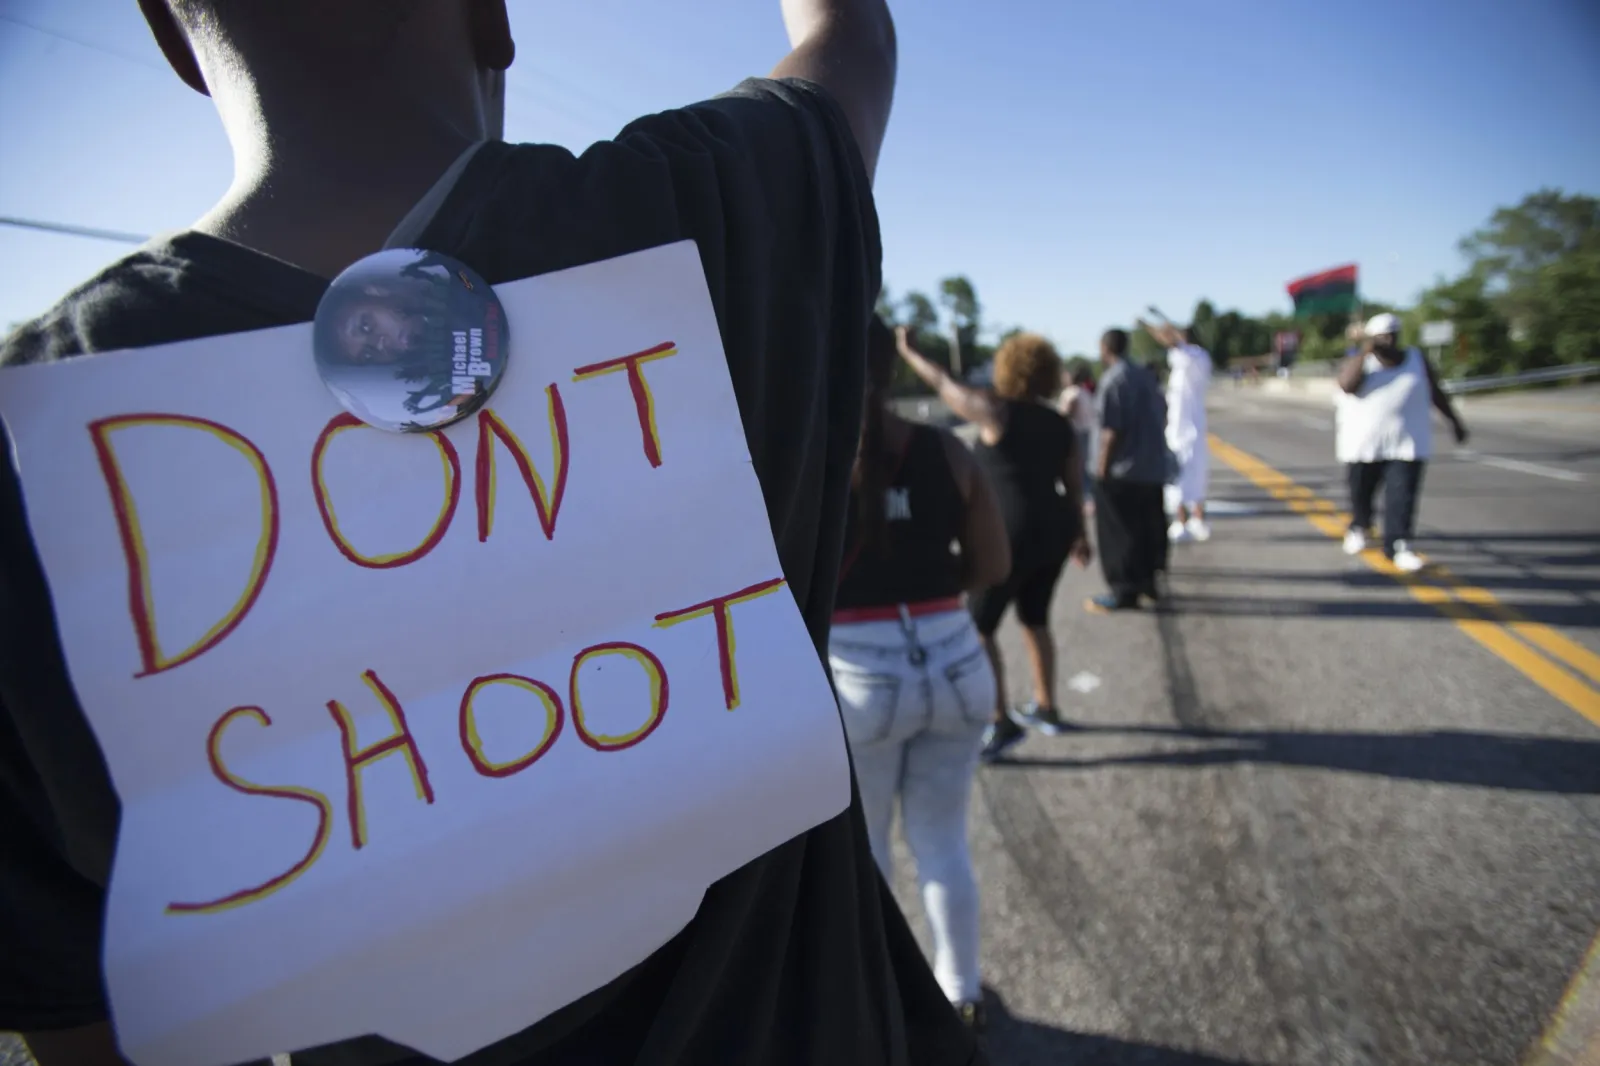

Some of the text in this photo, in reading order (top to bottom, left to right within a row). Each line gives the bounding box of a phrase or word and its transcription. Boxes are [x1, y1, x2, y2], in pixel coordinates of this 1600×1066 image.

[452, 331, 476, 395] Michael
[468, 328, 491, 376] Brown
[88, 342, 677, 678] DONT
[165, 578, 785, 914] SHOOT
